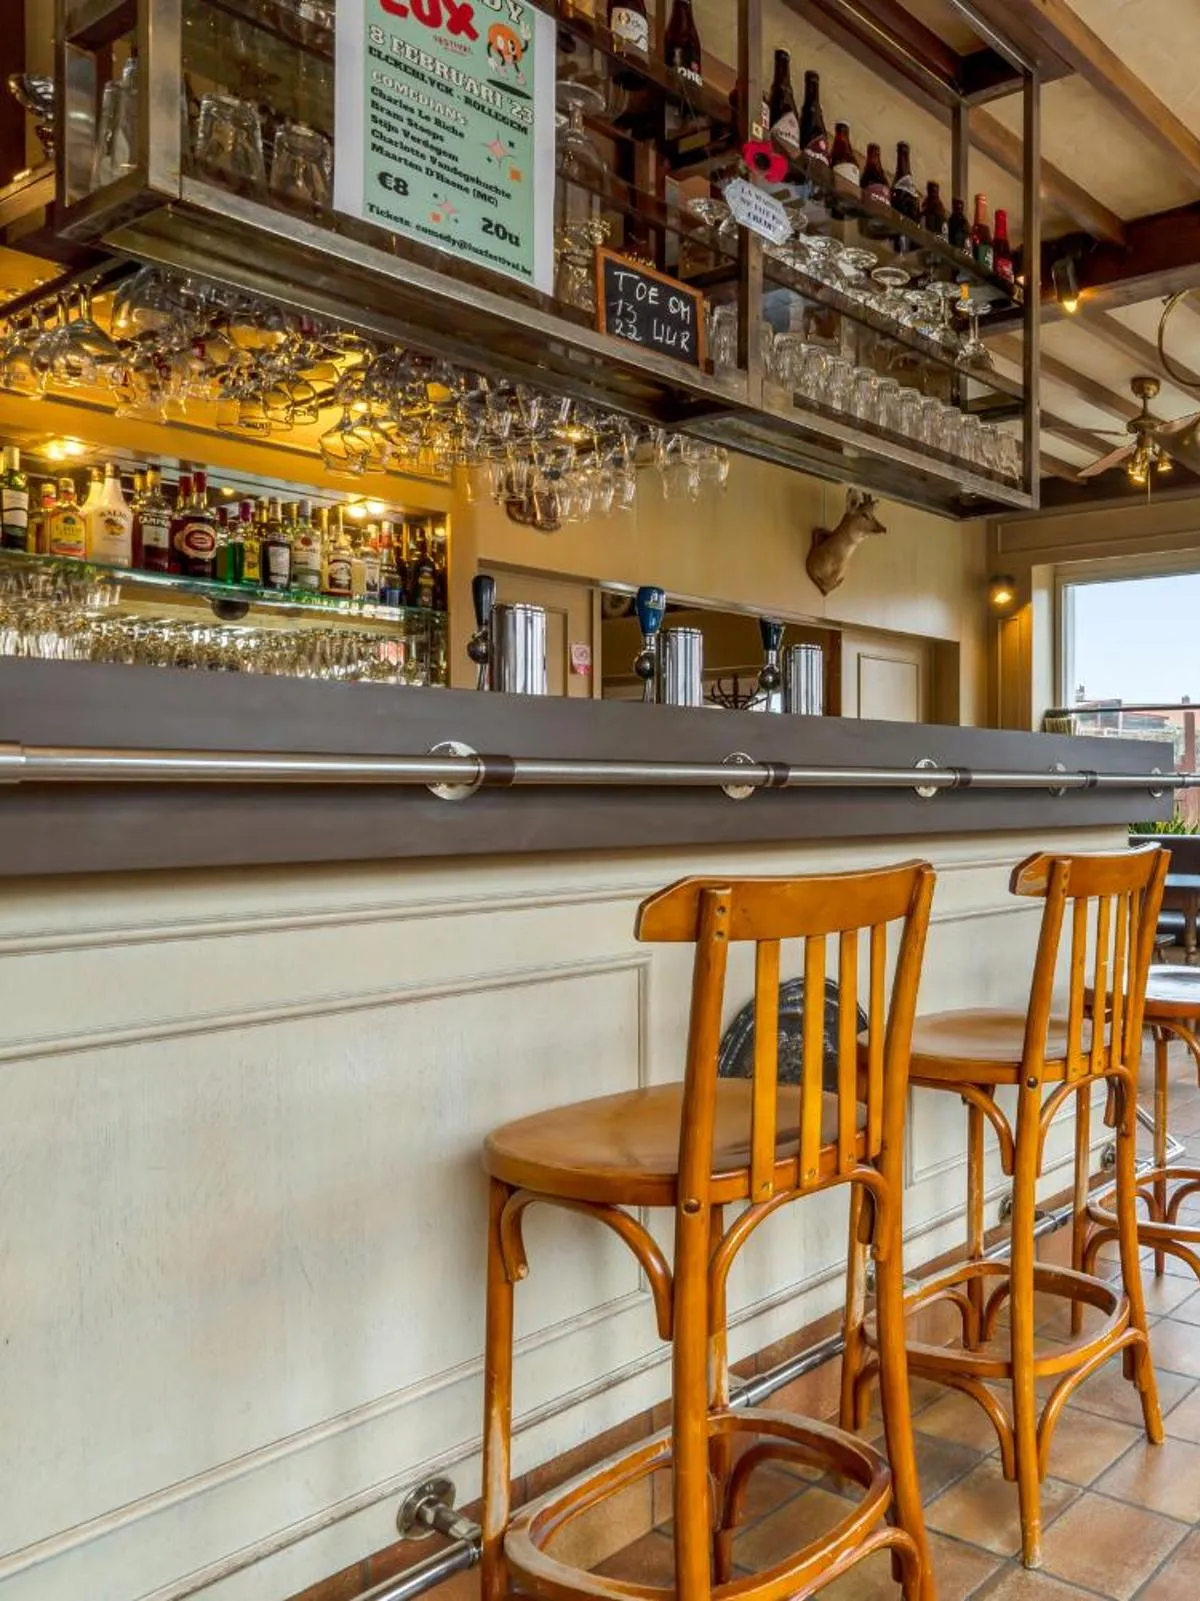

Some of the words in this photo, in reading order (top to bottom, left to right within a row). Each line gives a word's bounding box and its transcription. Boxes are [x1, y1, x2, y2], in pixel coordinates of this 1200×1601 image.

[368, 24, 385, 46] 8
[390, 34, 503, 110] FEBRUARI
[370, 85, 415, 114] Charles
[417, 108, 431, 122] Le
[370, 99, 404, 122] Bram
[371, 69, 468, 126] COMEDIANS
[463, 95, 529, 135] ROLLEGEM
[370, 128, 426, 160] Charlotte
[370, 142, 423, 172] Maarten
[377, 171, 409, 196] €8
[480, 216, 522, 248] 20u
[613, 271, 660, 305] TOE
[615, 318, 643, 342] 22
[653, 318, 690, 353] UUR
